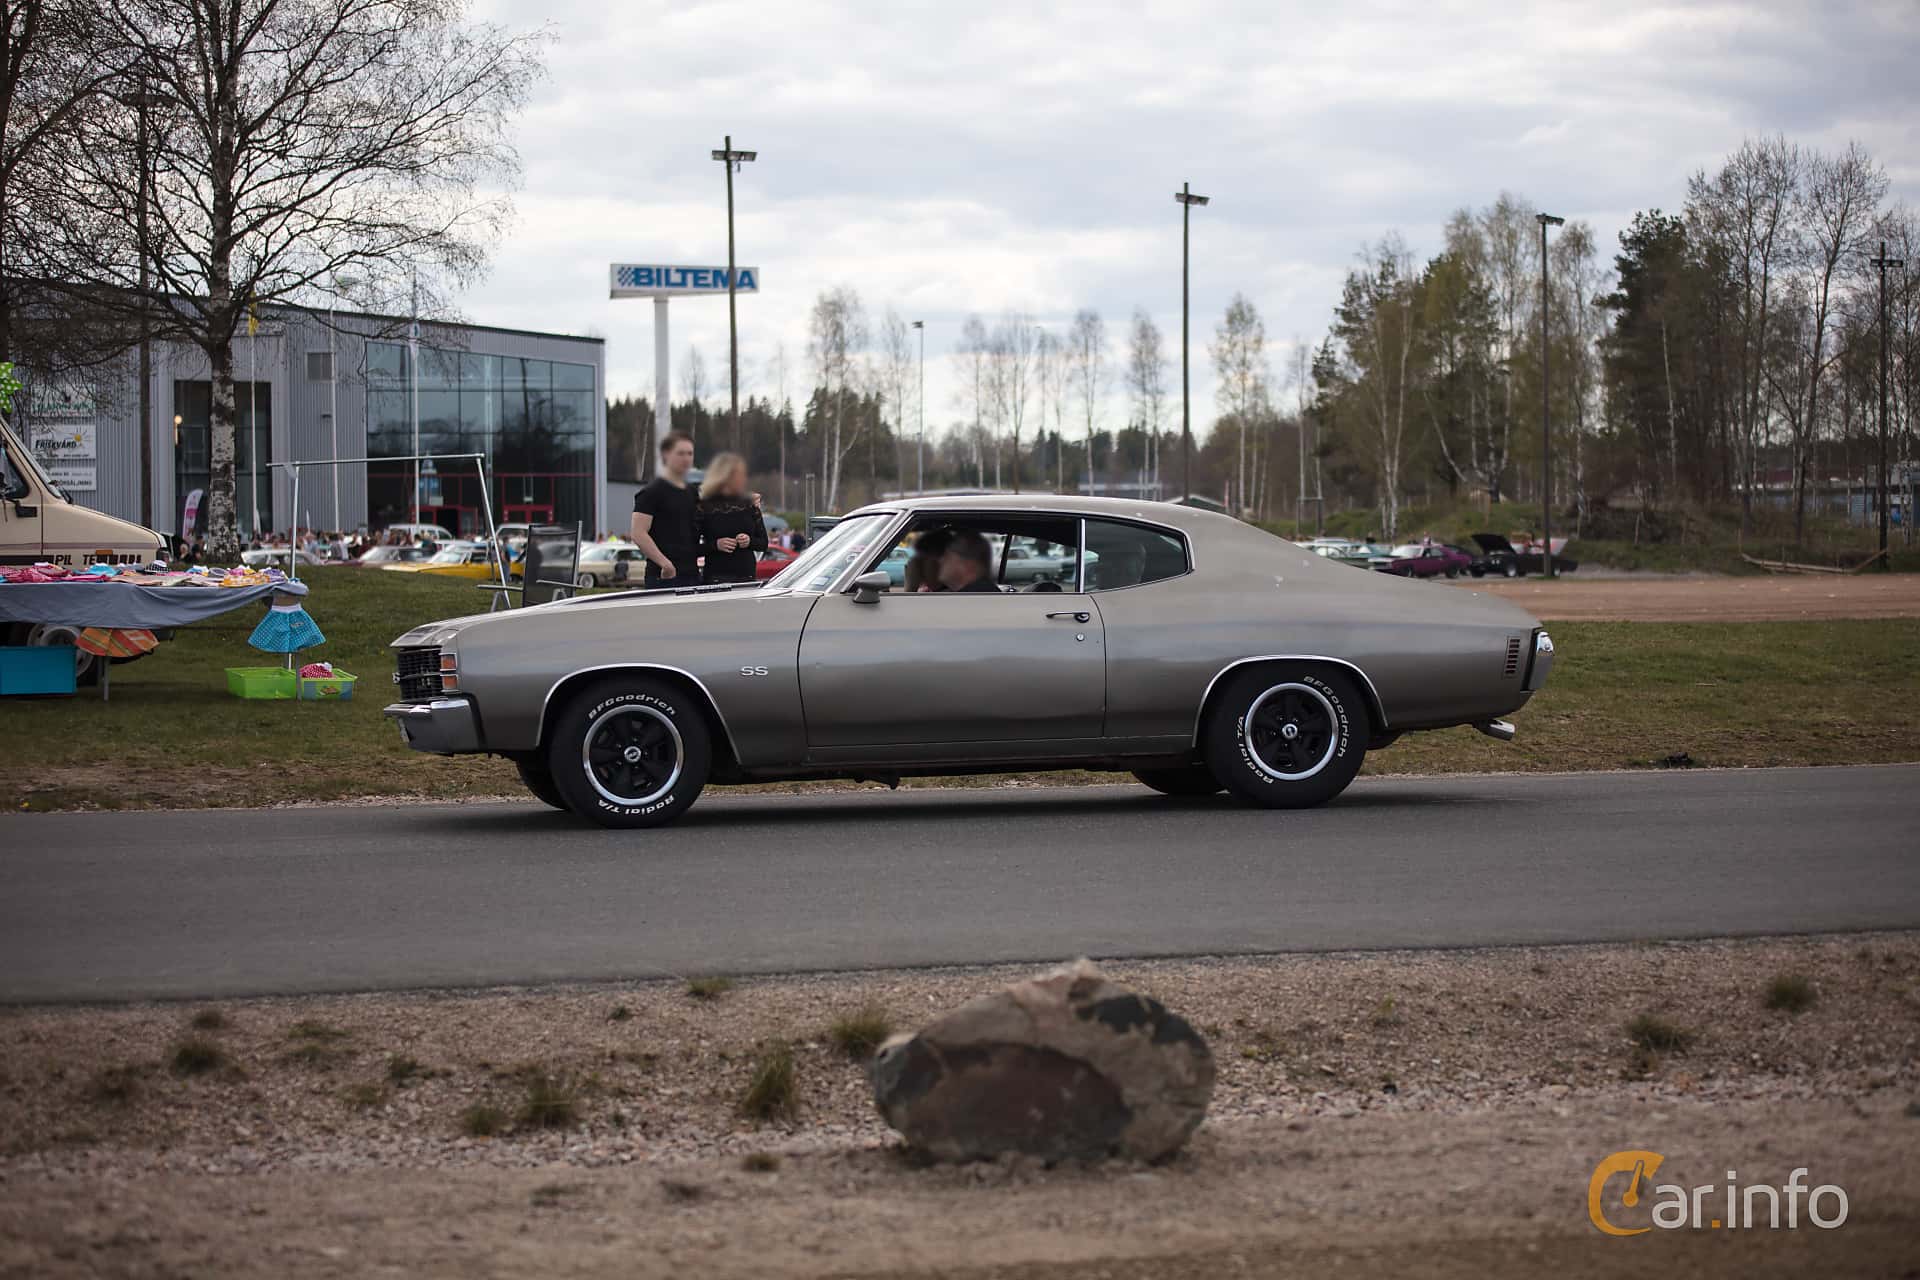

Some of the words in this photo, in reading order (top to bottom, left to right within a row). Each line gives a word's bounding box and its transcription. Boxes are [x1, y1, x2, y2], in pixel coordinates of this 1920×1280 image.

[632, 267, 757, 289] BILTEMA
[740, 665, 769, 676] SS
[588, 693, 677, 720] BFGoodrich
[1302, 675, 1351, 758] BFGoodrich
[1236, 715, 1245, 739] T/A
[1238, 742, 1274, 784] Radial
[598, 799, 622, 813] T/A
[624, 795, 675, 816] Radial
